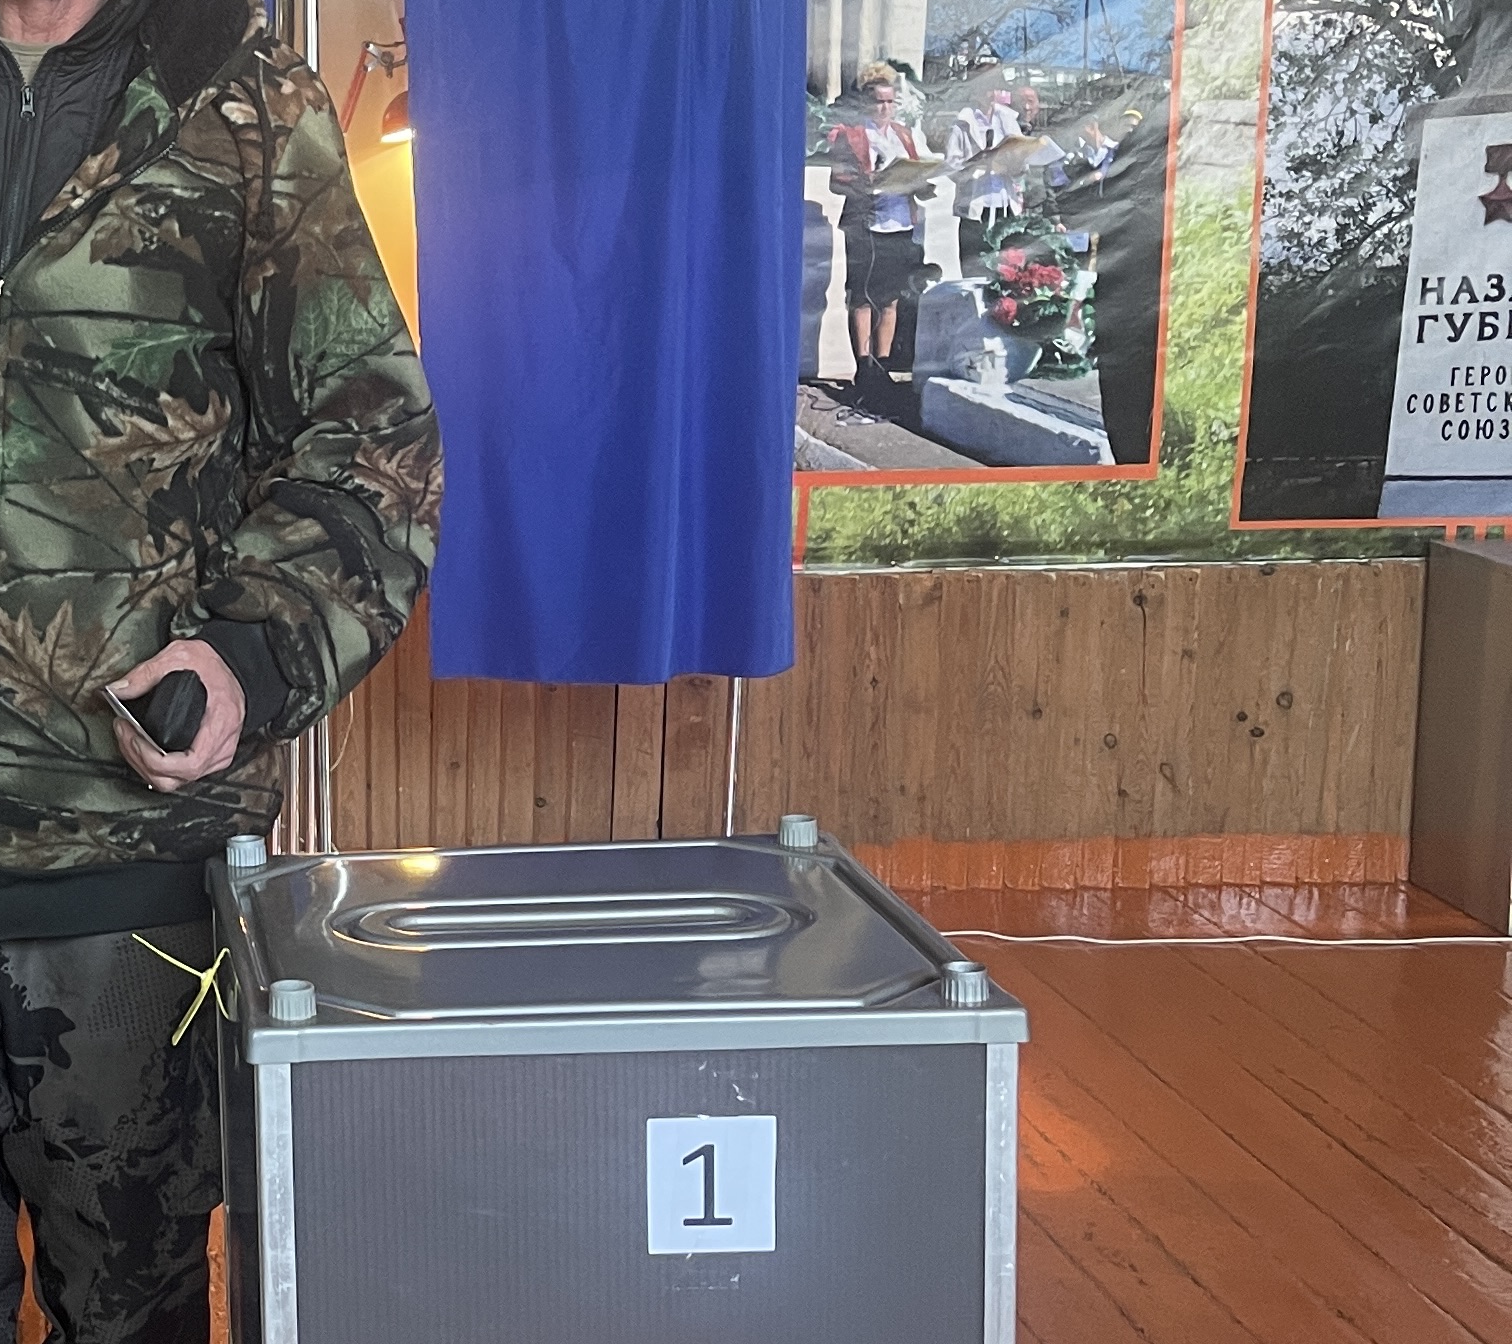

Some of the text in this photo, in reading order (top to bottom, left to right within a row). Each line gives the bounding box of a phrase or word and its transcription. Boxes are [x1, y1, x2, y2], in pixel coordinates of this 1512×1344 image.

[1419, 273, 1512, 306] НАЗ
[1416, 309, 1512, 344] ГУБ
[1441, 418, 1510, 441] СОЮЗ
[682, 1143, 733, 1227] 1
